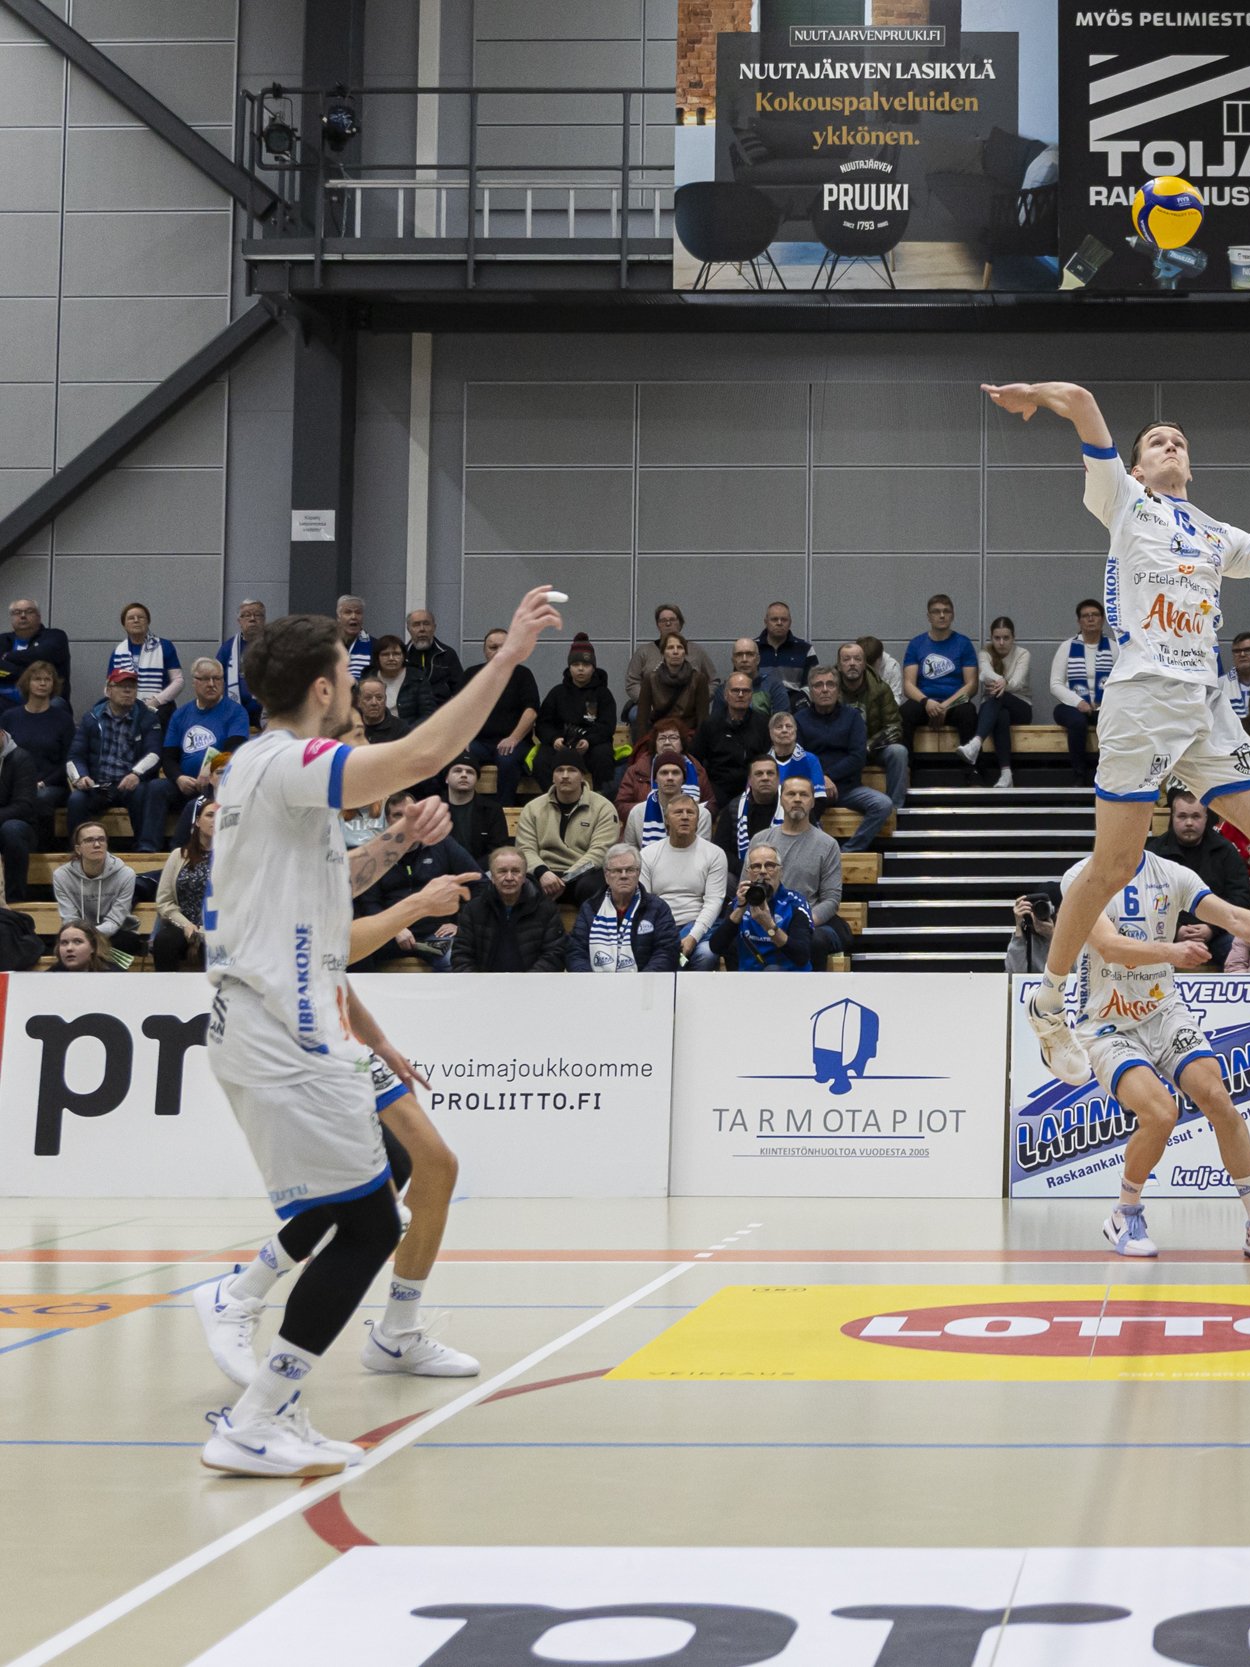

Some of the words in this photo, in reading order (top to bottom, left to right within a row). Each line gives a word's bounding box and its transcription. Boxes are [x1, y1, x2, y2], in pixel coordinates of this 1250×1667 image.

[1075, 9, 1133, 27] MYÖS
[794, 29, 941, 42] NUUTAJARVENPRUUKI.FI
[739, 58, 892, 80] NUUTAJÄRVEN
[896, 58, 996, 80] LASIKYLÄ
[755, 91, 979, 116] Kokouspalveluiden
[812, 125, 920, 150] ykkönen.
[840, 158, 893, 174] NUUTAJÄRVEN
[823, 183, 909, 211] PRUUKI
[856, 220, 875, 231] 1793
[345, 819, 384, 830] NIKE
[1124, 886, 1139, 916] 6
[441, 1057, 653, 1082] voimajoukkoomme
[431, 1092, 602, 1111] PROLIITTO.FI
[759, 1146, 857, 1157] KIINTEISTÖNHUOLTOA
[859, 1148, 907, 1157] VUODESTA
[908, 1148, 930, 1157] 2005
